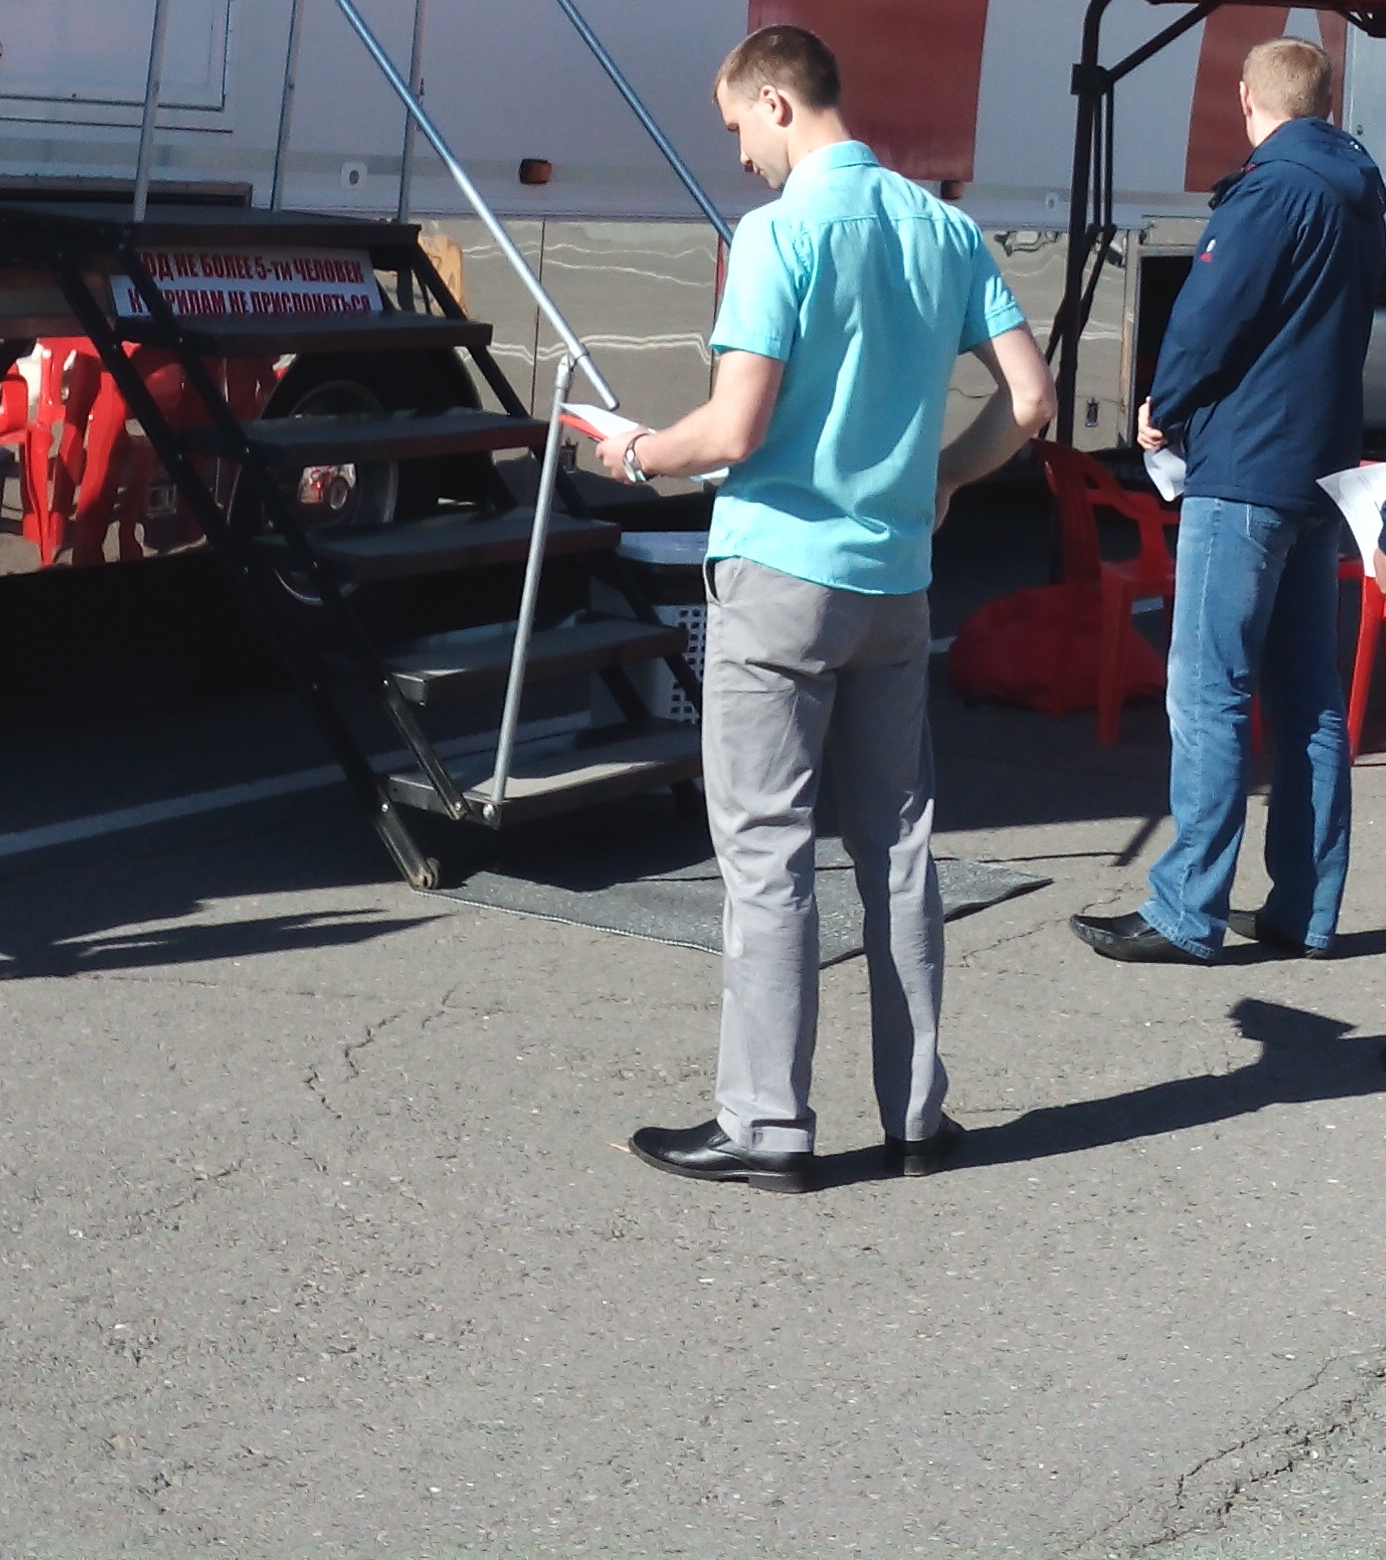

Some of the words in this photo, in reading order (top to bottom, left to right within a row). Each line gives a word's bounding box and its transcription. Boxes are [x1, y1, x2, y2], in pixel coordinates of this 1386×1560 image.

[174, 252, 198, 278] НЕ
[199, 254, 253, 279] БОЛЕЕ
[293, 258, 365, 284] ЧЕЛОВЕК
[227, 290, 250, 314] НЕ
